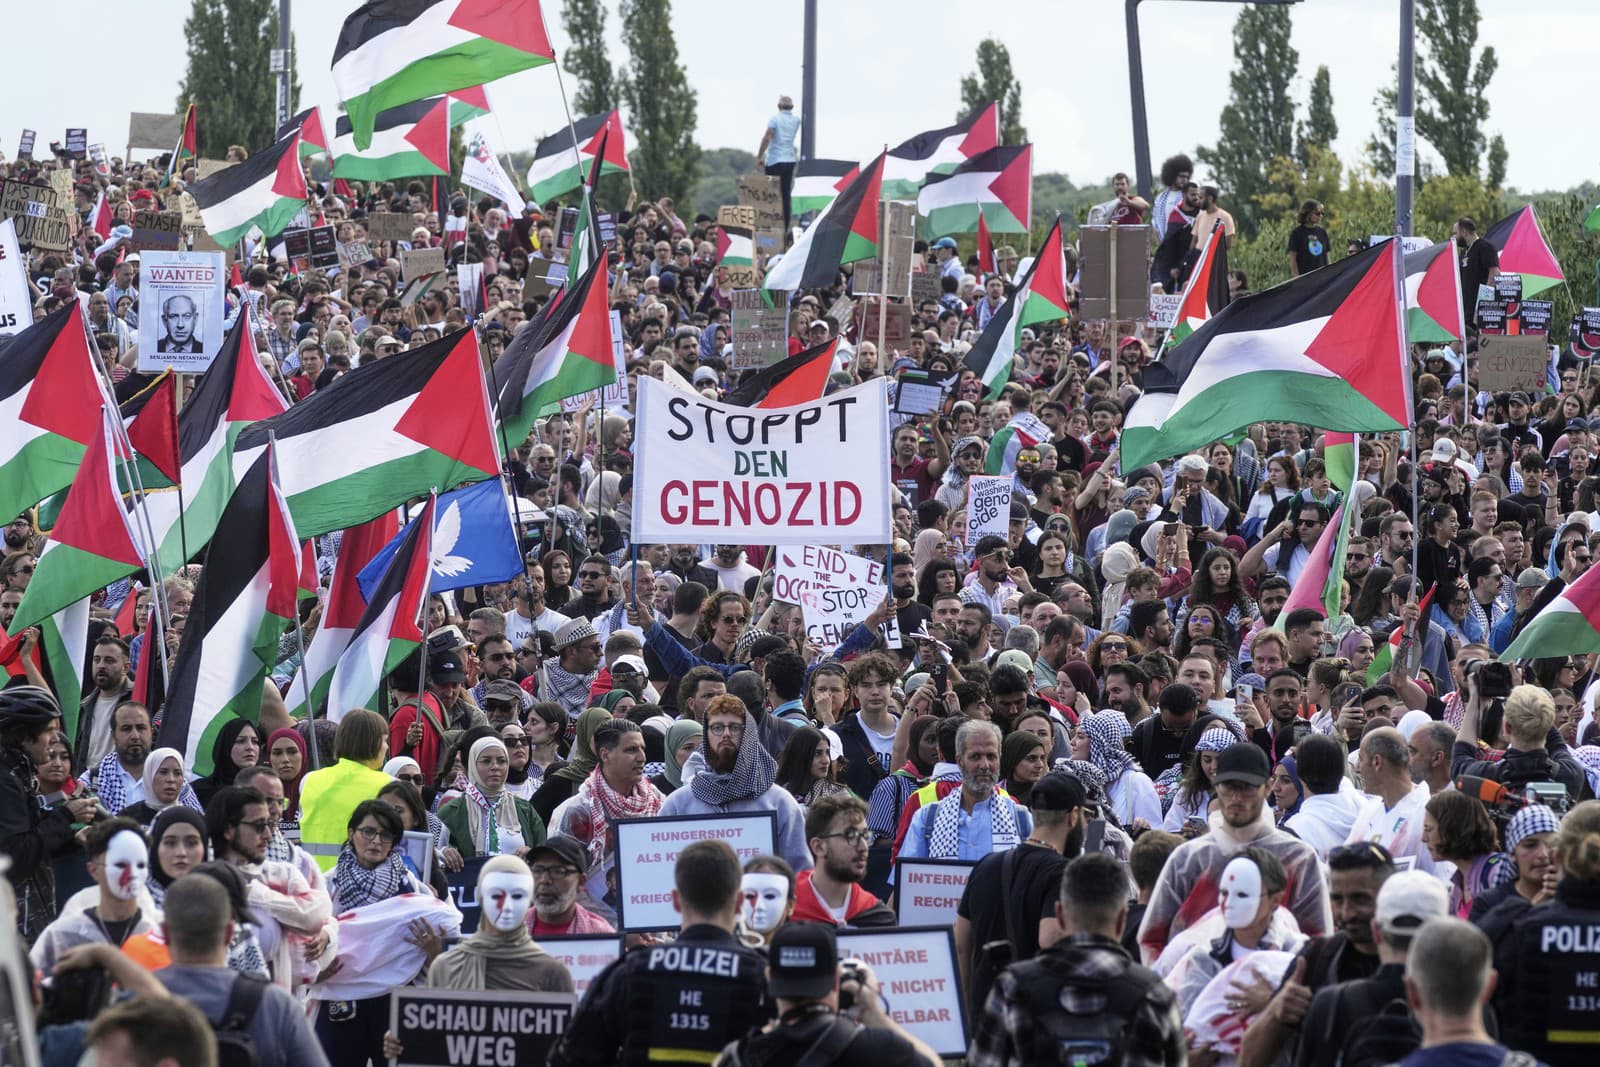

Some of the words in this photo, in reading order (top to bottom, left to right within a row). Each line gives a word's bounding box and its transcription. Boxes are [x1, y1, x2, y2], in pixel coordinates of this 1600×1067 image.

[135, 212, 180, 232] SMASH
[150, 269, 215, 281] WANTED
[667, 397, 857, 445] STOPPT
[734, 450, 788, 478] DEN
[972, 479, 1000, 492] White-
[977, 484, 1011, 498] washing
[660, 479, 862, 526] GENOZID
[974, 493, 1010, 513] geno
[968, 506, 999, 530] cide
[803, 545, 847, 574] END
[814, 571, 832, 582] THE
[822, 587, 868, 613] STOP
[650, 828, 744, 842] HUNGERSNOT
[636, 853, 662, 864] ALS
[903, 872, 970, 886] INTERNA
[630, 892, 673, 905] KRIEG
[648, 947, 740, 978] POLIZEI
[891, 978, 947, 995] NICHT
[1576, 971, 1599, 987] HE
[680, 990, 703, 1007] HE
[403, 1003, 487, 1033] SCHAU
[492, 1007, 568, 1035] NICHT
[669, 1011, 710, 1031] 1315
[890, 1007, 951, 1024] ELBAR
[446, 1034, 516, 1067] WEG
